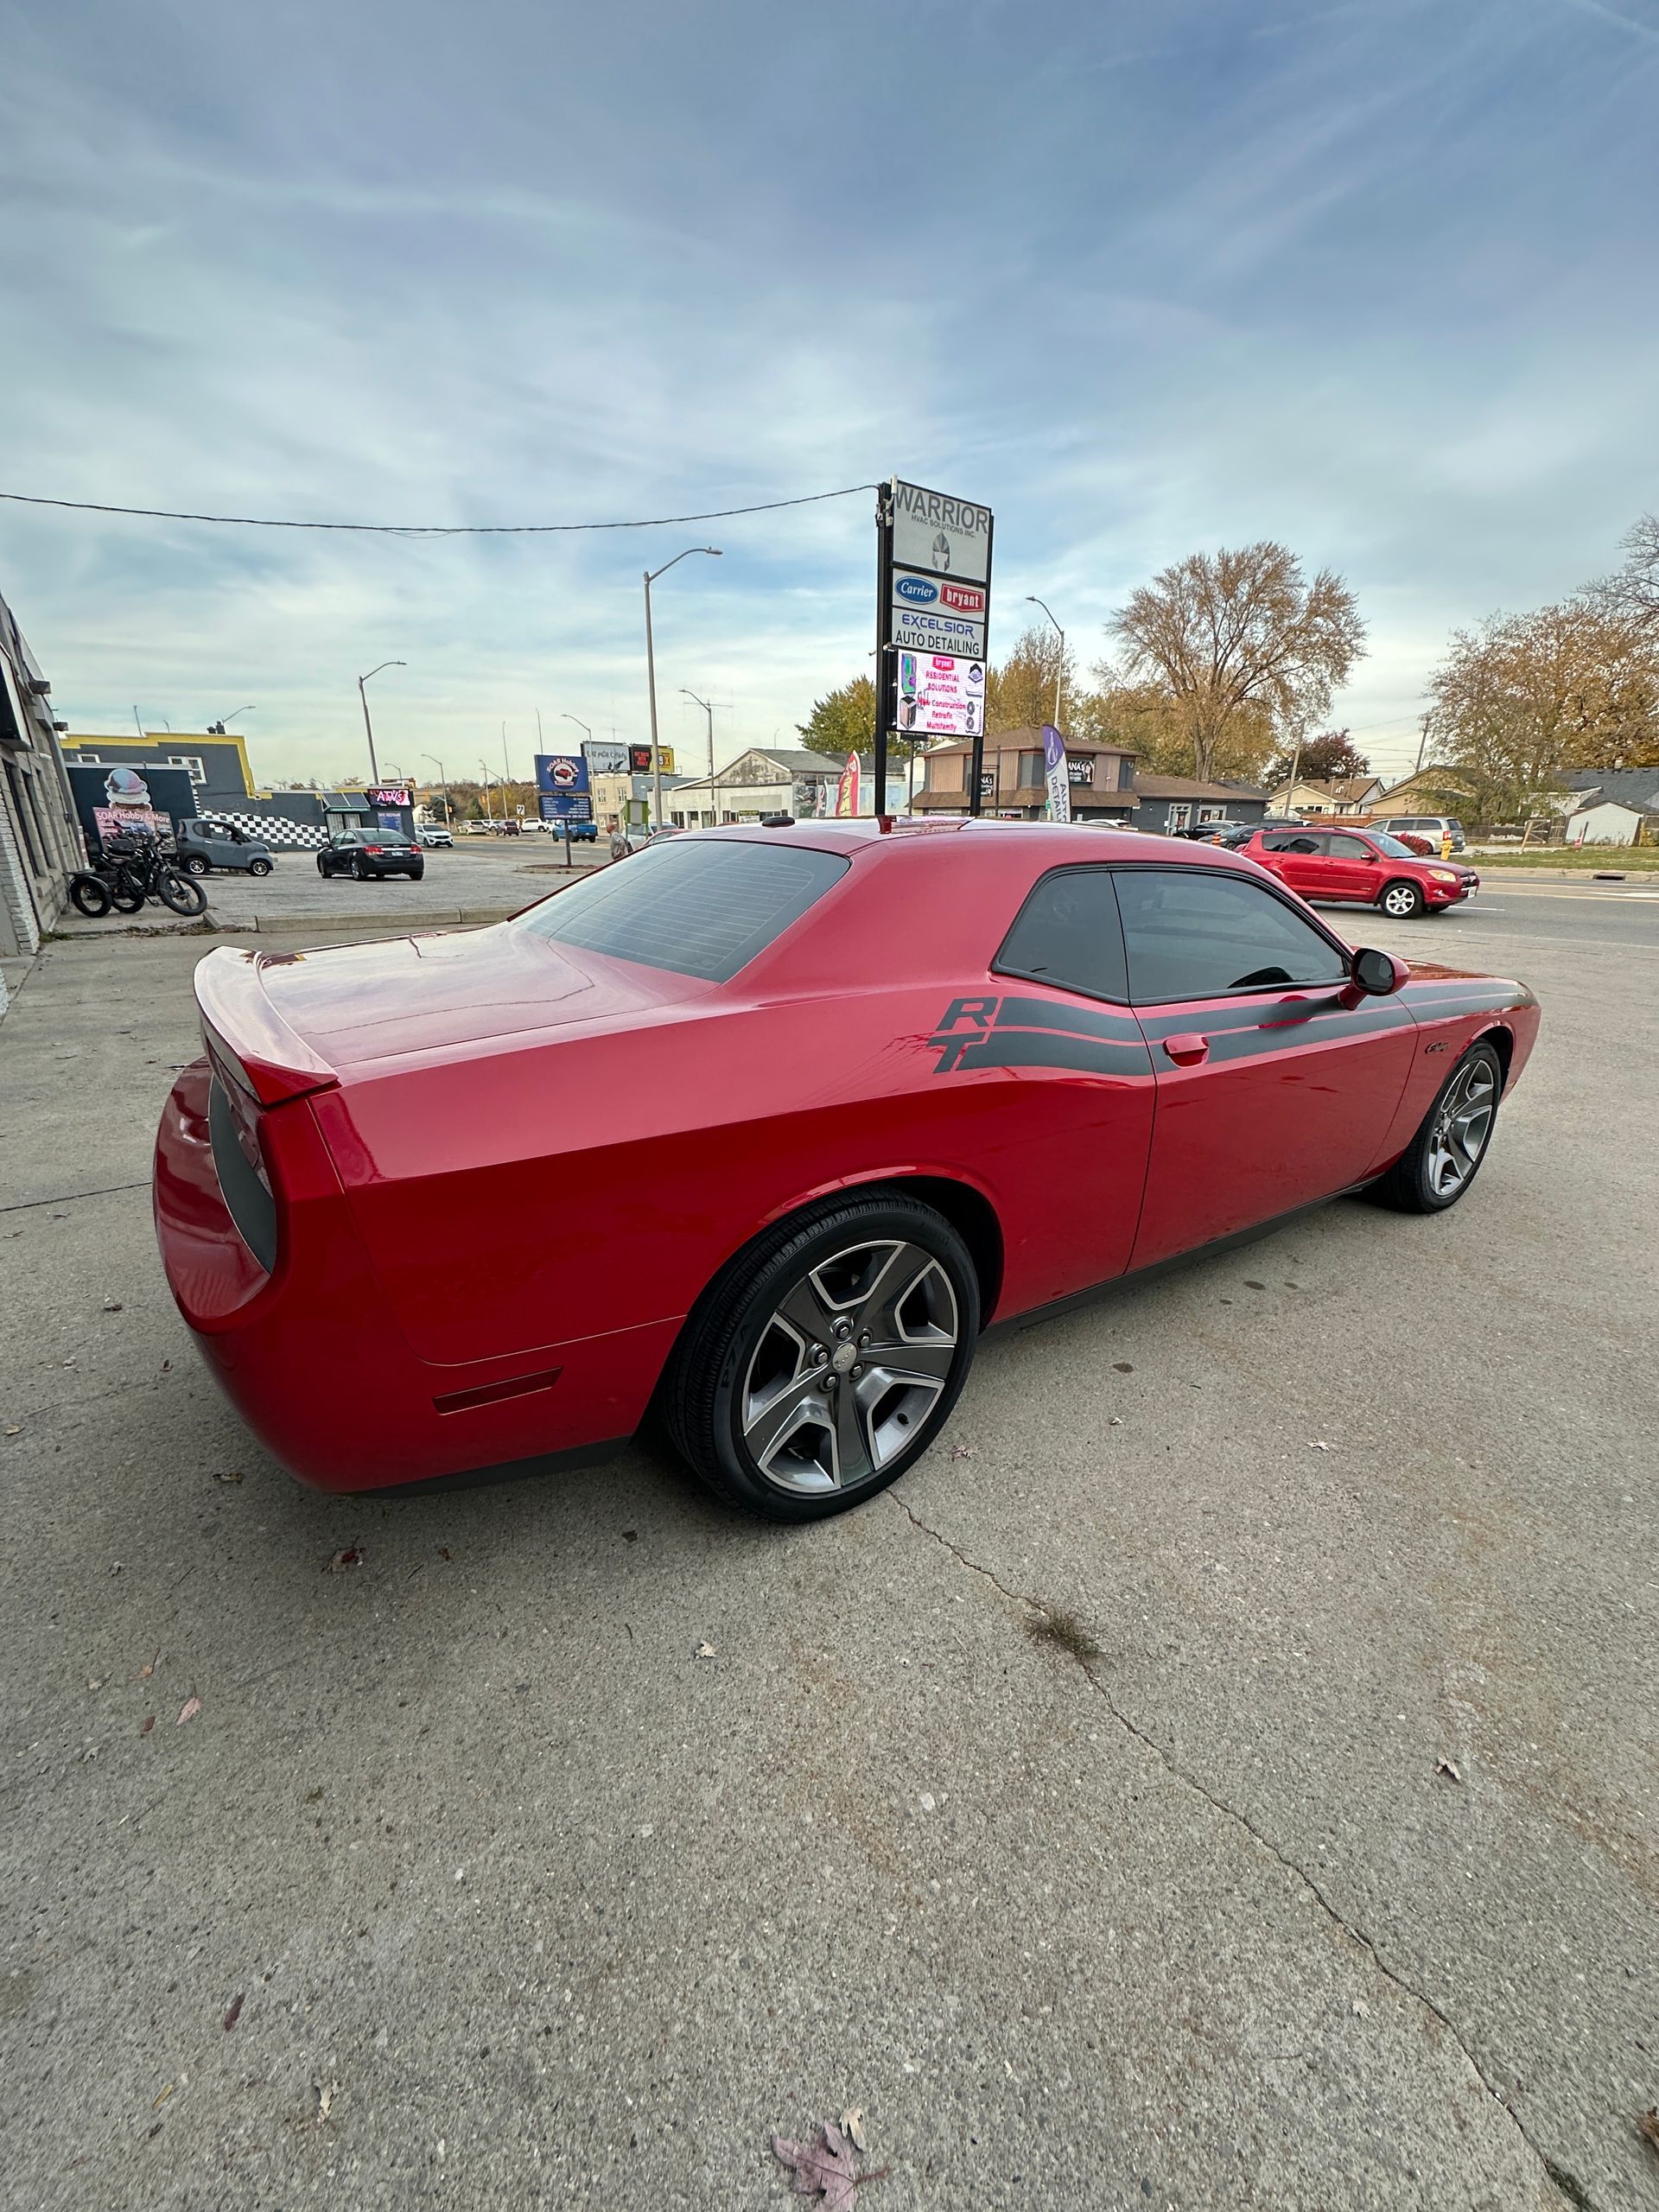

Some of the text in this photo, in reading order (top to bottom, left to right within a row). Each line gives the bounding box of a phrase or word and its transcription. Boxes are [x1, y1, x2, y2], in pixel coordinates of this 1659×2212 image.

[895, 486, 988, 534] WARRIOR
[911, 513, 928, 525] HVAC
[929, 520, 963, 535] SOLUTIONS
[900, 582, 934, 598] Carrier
[946, 588, 979, 608] bryant
[902, 613, 975, 639] EXCELSIOR
[895, 630, 980, 655] AUTO DETAILING
[925, 671, 960, 683] RESIDENTIAL
[927, 683, 958, 694] SOLUTIONS
[931, 699, 966, 709] Construction
[931, 710, 953, 719] Retrofit
[926, 721, 957, 733] Multifamily
[96, 811, 118, 821] SOAR
[119, 811, 143, 822] Hobby
[151, 813, 170, 823] More
